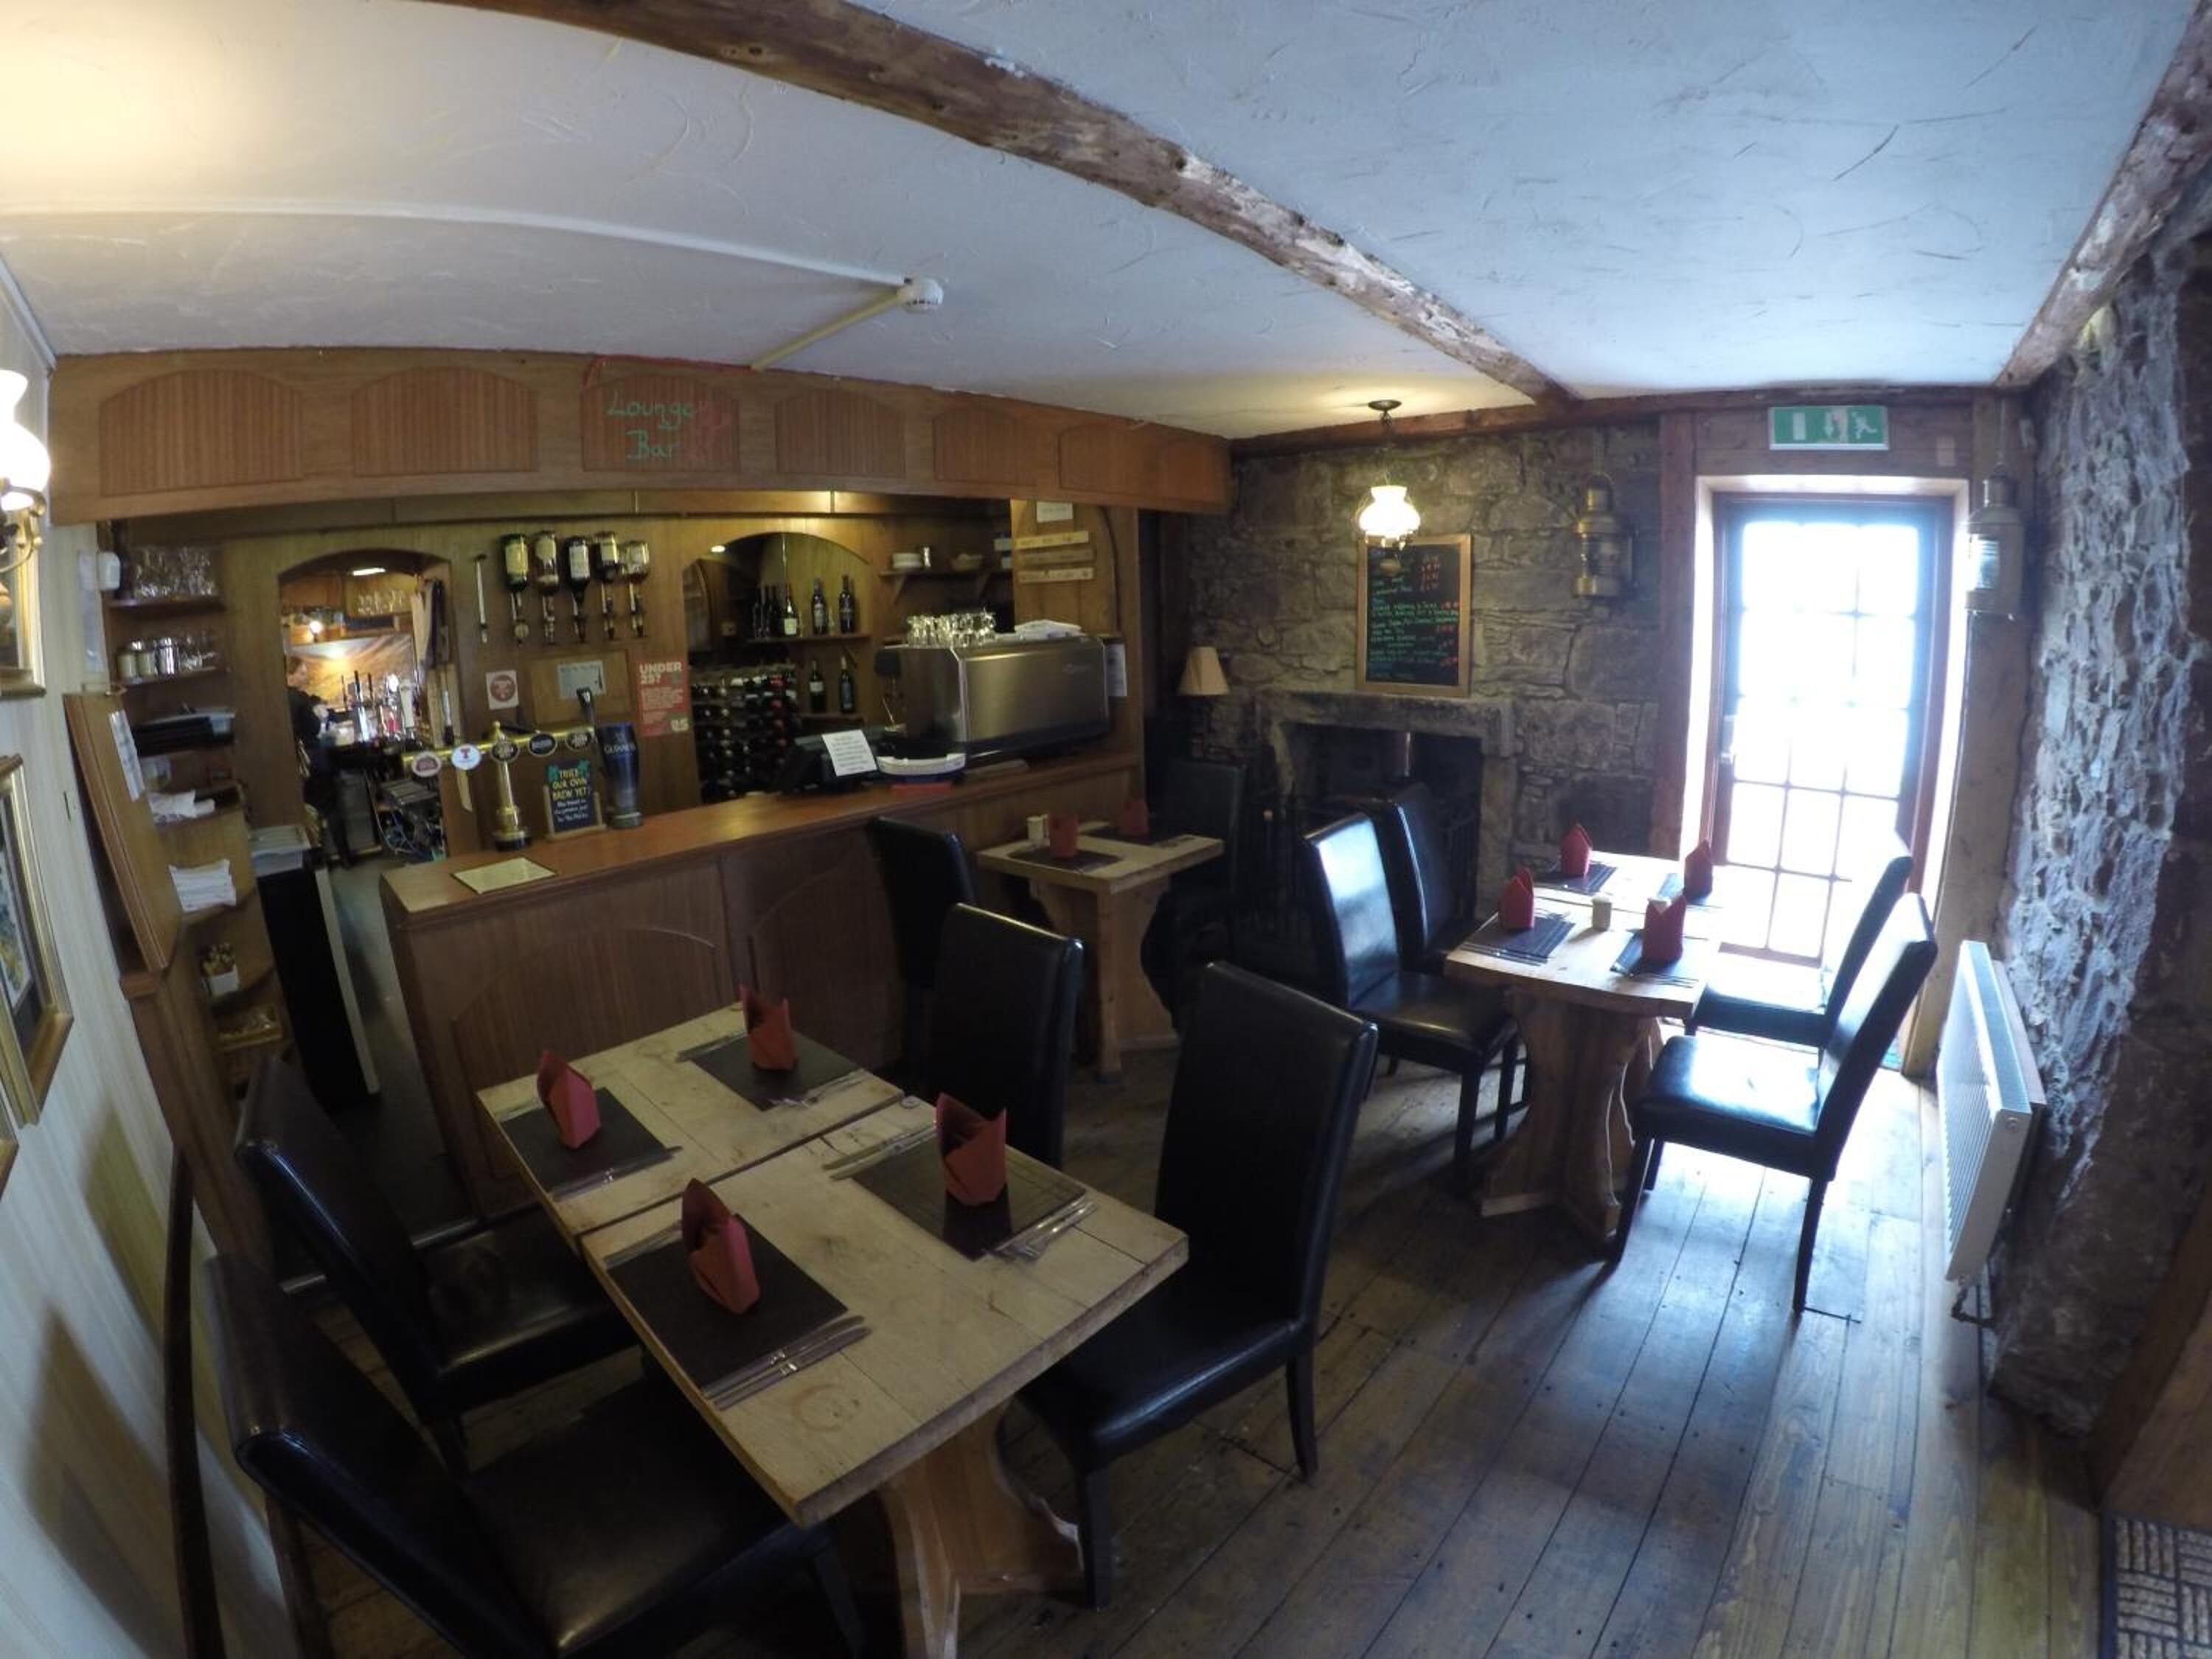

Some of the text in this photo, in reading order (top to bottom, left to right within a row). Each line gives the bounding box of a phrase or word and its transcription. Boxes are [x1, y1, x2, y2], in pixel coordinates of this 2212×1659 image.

[606, 390, 695, 430] Lounge
[625, 429, 675, 461] Bar
[639, 661, 683, 673] UNDER
